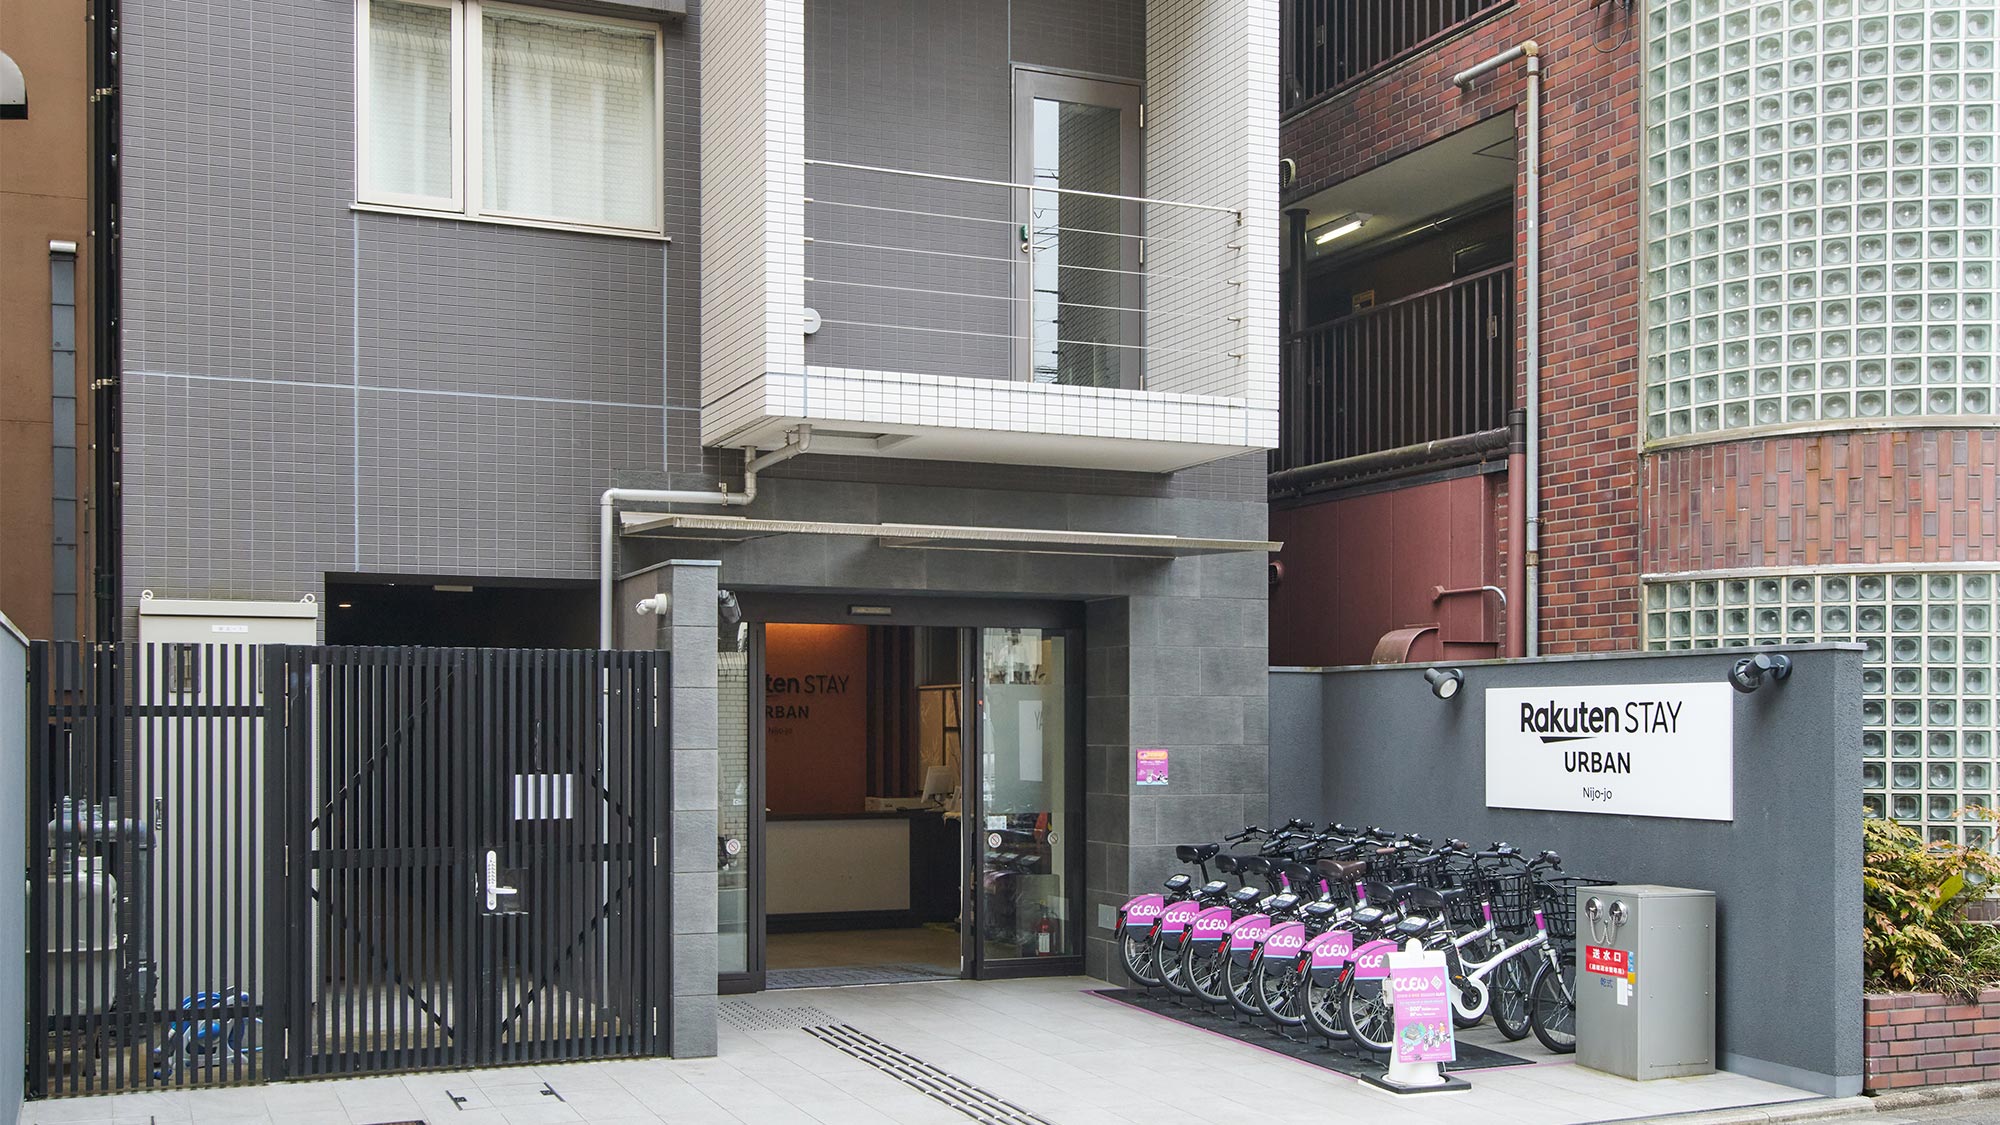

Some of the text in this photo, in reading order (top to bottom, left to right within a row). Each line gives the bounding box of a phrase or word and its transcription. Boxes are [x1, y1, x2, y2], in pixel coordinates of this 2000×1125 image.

[804, 674, 850, 694] STAY
[766, 704, 809, 719] RBAN
[1520, 700, 1683, 733] Rakuten STAY
[1564, 751, 1631, 774] URBAN
[1583, 786, 1613, 802] Nijo-jo
[1592, 948, 1622, 963] 送水口
